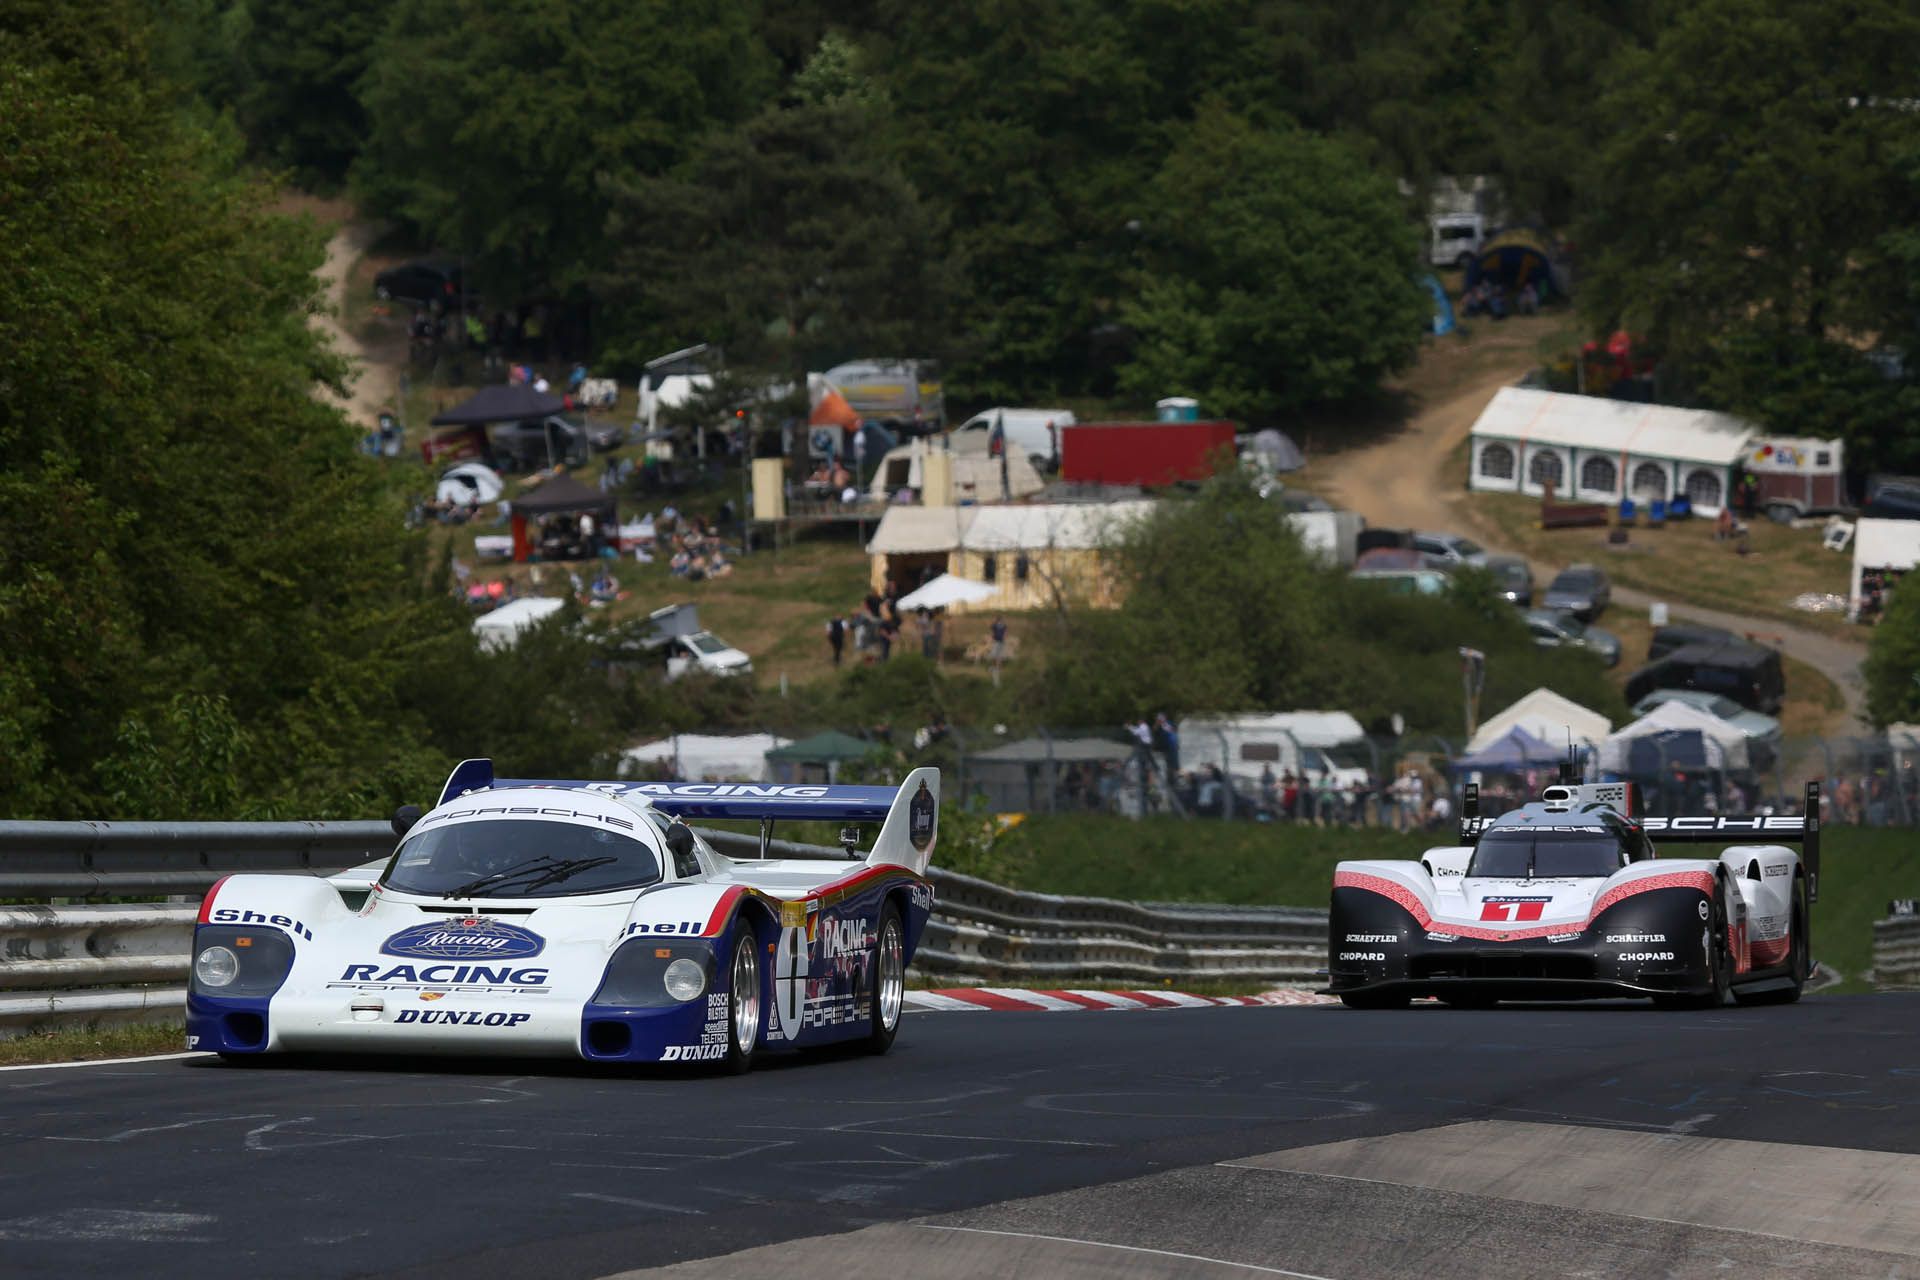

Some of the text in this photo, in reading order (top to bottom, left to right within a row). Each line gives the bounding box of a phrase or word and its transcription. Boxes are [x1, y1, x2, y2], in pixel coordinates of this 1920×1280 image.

[584, 782, 829, 797] RACING
[421, 807, 634, 831] PORSCHE
[912, 885, 930, 912] Shell
[1498, 903, 1521, 921] 1
[213, 909, 313, 941] Shell
[416, 931, 511, 949] Racing
[823, 918, 867, 959] RACING
[1345, 934, 1398, 943] SCHAEFFLER
[1606, 934, 1666, 943] SCHAEFFLER
[1339, 952, 1385, 961] CHOPARD
[1619, 952, 1674, 961] CHOPARD
[340, 964, 550, 984] RACING
[789, 927, 799, 1020] 1
[326, 984, 551, 994] PORSCHE
[708, 993, 728, 1007] BOSCH
[394, 1009, 531, 1027] DUNLOP
[707, 1007, 728, 1020] BILSTEIN
[802, 1002, 871, 1028] PORSCHE
[701, 1033, 728, 1044] TELETRON
[659, 1043, 729, 1061] DUNLOP
